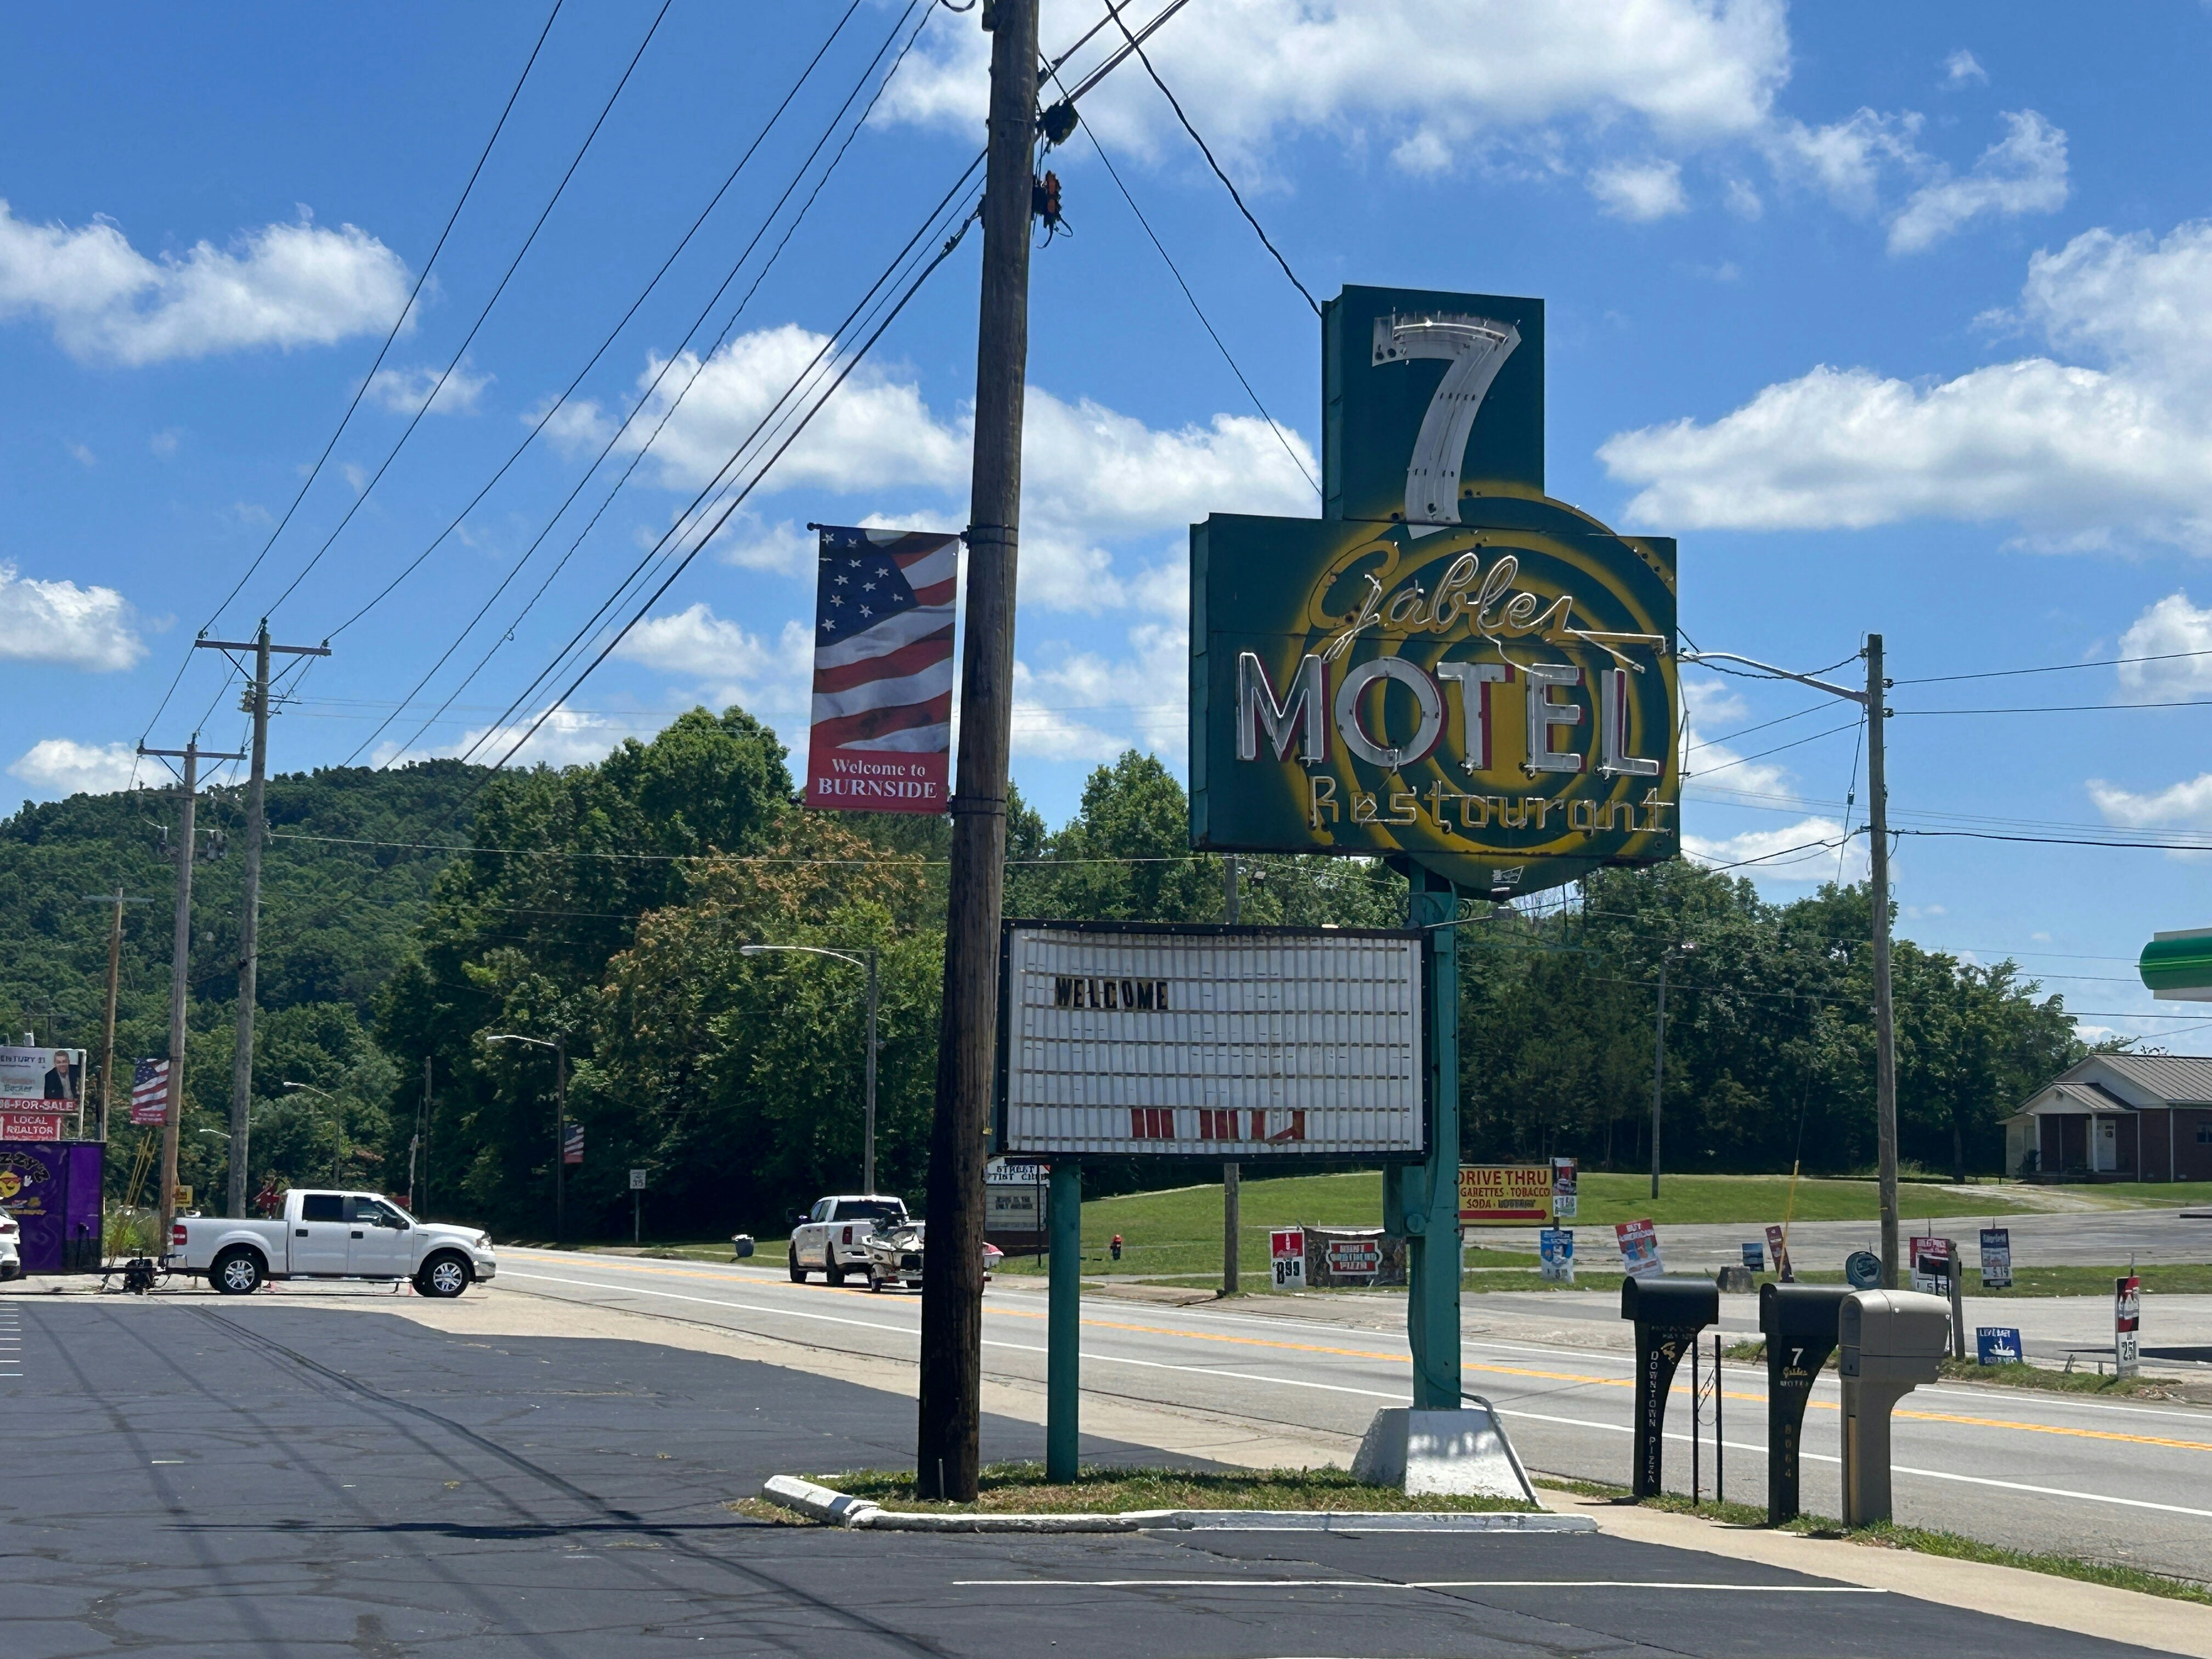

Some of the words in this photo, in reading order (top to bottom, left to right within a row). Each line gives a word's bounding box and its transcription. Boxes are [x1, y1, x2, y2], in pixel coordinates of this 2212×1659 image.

[1372, 308, 1522, 540] 7
[1308, 540, 1668, 662] Gables
[1235, 652, 1664, 777] MOTEL
[832, 758, 905, 776] Welcome
[911, 763, 926, 777] to
[818, 777, 937, 799] BURNSIDE
[1055, 977, 1169, 1010] WELCOME
[0, 1055, 35, 1063] ENTURY
[14, 1115, 48, 1125] LOCAL
[6, 1125, 54, 1135] REALTOR
[1459, 1170, 1502, 1186] DRIVE
[1505, 1170, 1547, 1186] THRU
[1460, 1187, 1504, 1197] GARETTES
[1510, 1187, 1550, 1198] TOBACCO
[1466, 1199, 1492, 1209] SODA
[1791, 1347, 1804, 1366] 7
[1648, 1350, 1660, 1427] DOWNTOWN
